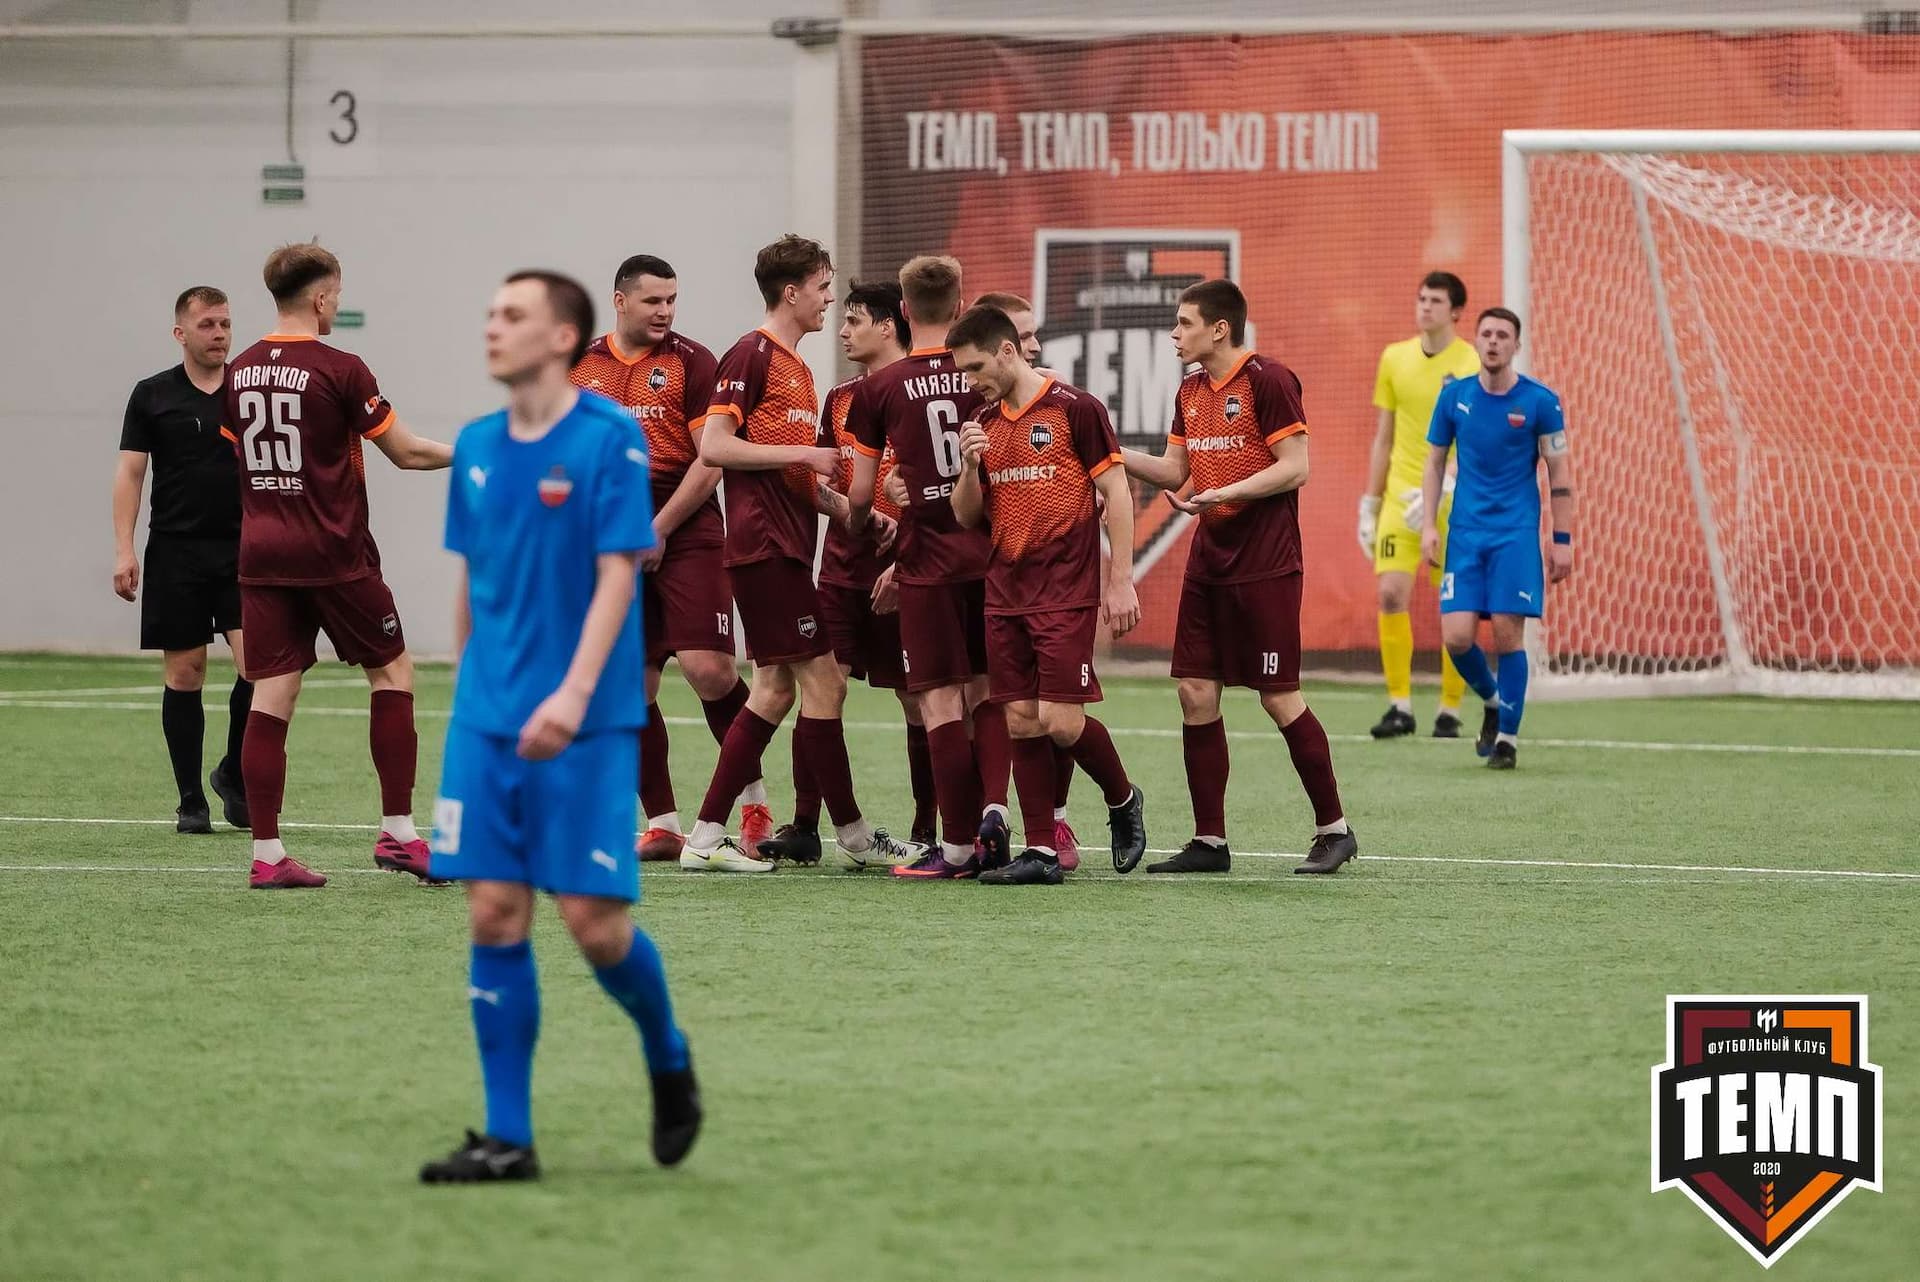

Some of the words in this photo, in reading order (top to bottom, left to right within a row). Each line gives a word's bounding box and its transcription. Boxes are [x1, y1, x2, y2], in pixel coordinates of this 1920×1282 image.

[330, 90, 357, 144] 3
[907, 112, 1008, 176] ТЕМП,
[1018, 112, 1121, 177] ТЕМП,
[1131, 111, 1266, 172] ТОЛЬКО
[1275, 111, 1379, 172] ТЕМП!
[233, 365, 311, 391] НОВИЧКОВ
[1042, 327, 1202, 434] ТЕМ
[239, 391, 303, 473] 25
[926, 399, 962, 478] 6
[1031, 431, 1052, 444] ТЕМП
[250, 476, 303, 490] SEUS
[922, 481, 955, 500] SE
[1380, 534, 1396, 558] 16
[716, 612, 729, 635] 13
[1081, 663, 1089, 687] 5
[1262, 652, 1279, 675] 19
